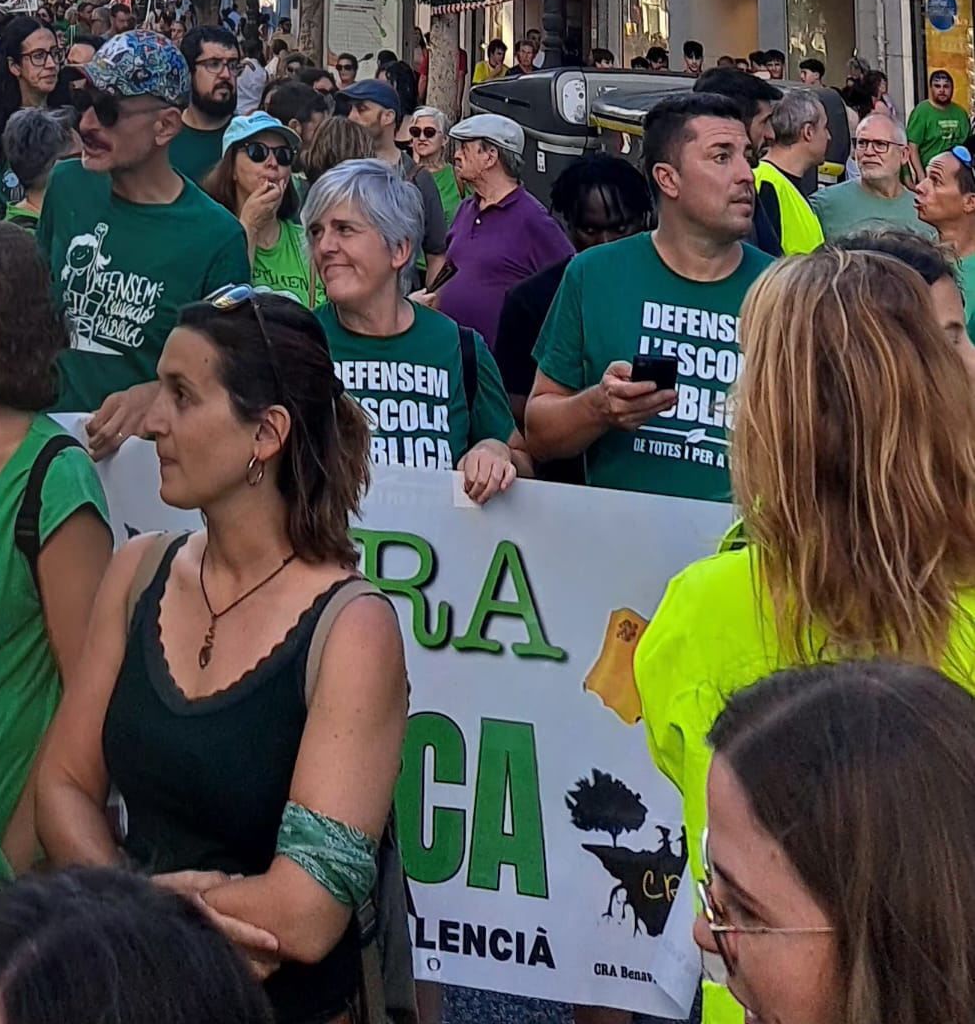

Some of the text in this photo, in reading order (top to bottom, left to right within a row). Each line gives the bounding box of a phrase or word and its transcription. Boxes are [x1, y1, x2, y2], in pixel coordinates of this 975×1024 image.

[642, 301, 741, 344] DEFENS
[353, 397, 451, 434] SCOLA
[633, 437, 647, 452] DE
[648, 439, 681, 457] TOTES
[692, 448, 714, 465] PER
[716, 453, 725, 468] A
[349, 527, 568, 661] RA
[395, 711, 548, 899] CA
[413, 917, 556, 970] LENCIÀ
[593, 962, 617, 977] CRA
